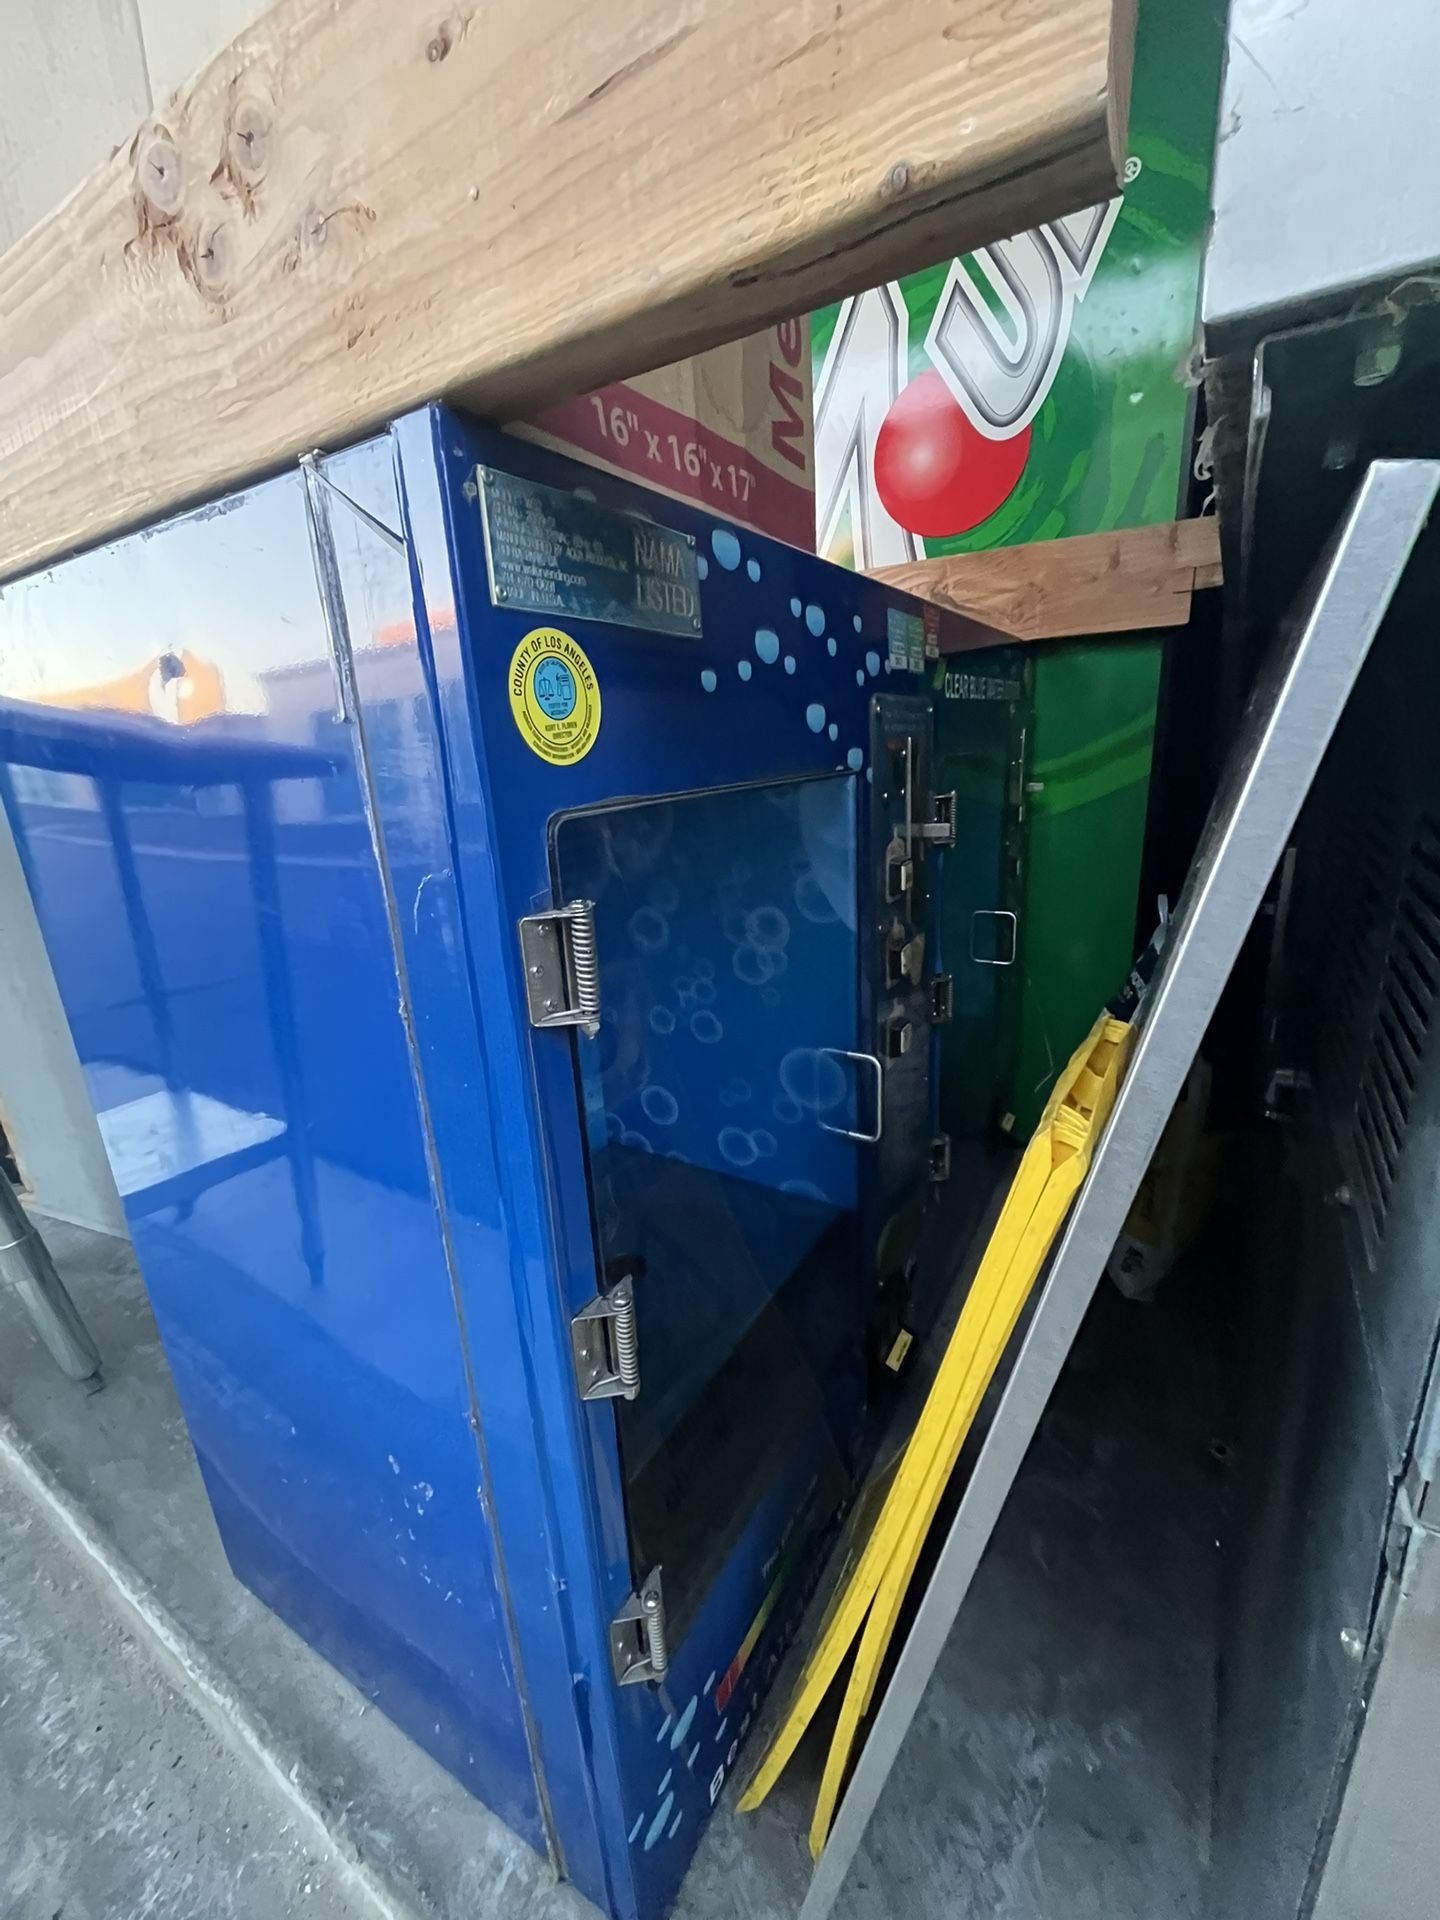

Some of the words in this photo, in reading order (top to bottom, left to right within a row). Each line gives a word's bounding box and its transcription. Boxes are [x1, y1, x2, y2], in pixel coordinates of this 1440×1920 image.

[590, 396, 638, 446] 16"
[644, 430, 663, 463] x
[667, 435, 707, 478] 16"
[710, 462, 723, 491] x
[633, 534, 686, 579] NAMA
[636, 573, 695, 618] LISTED
[513, 646, 532, 697] COUNTY
[530, 637, 542, 653] OF
[544, 635, 562, 650] LOS
[563, 643, 594, 691] ANGELES
[944, 672, 969, 699] CLEAR
